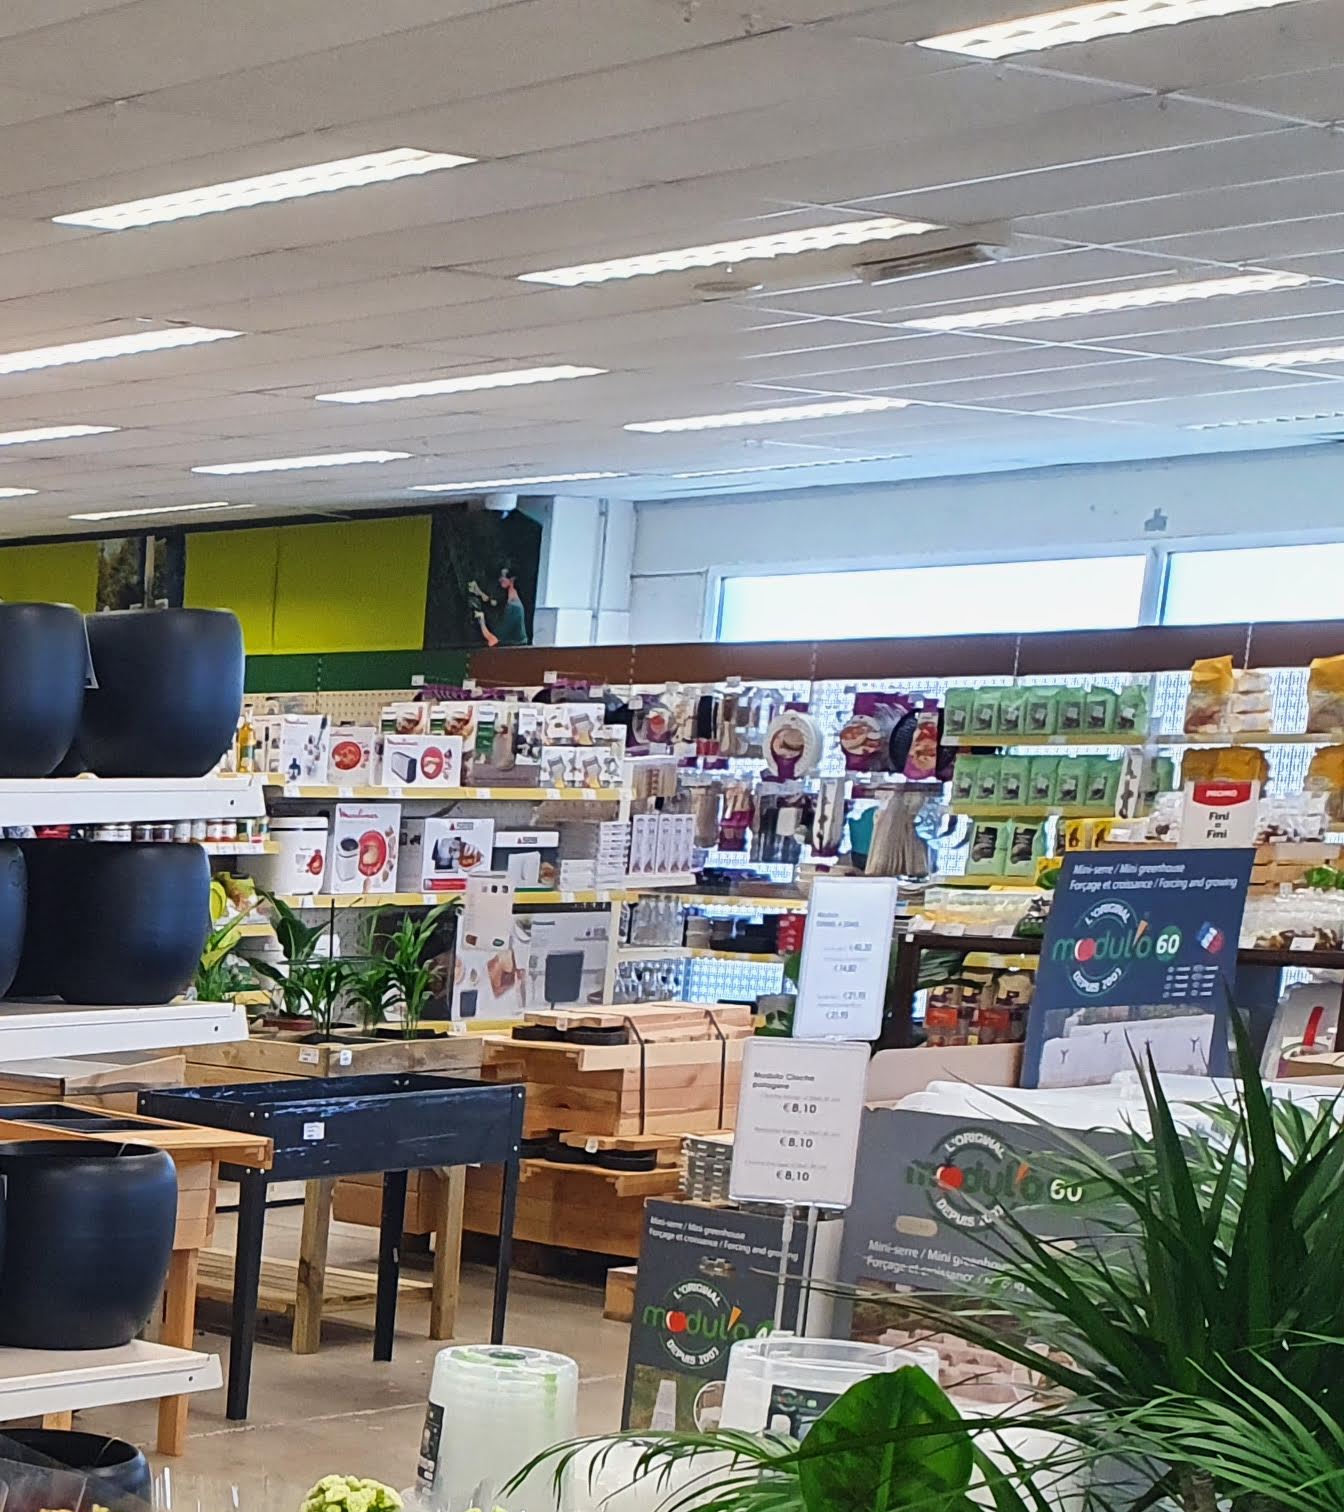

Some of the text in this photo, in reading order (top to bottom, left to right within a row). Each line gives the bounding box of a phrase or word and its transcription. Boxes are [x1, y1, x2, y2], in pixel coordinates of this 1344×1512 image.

[1209, 811, 1230, 820] Fini
[1206, 829, 1227, 838] Fini
[1156, 934, 1181, 954] 60
[935, 1198, 976, 1227] DEPUIS
[927, 1248, 951, 1263] Mini
